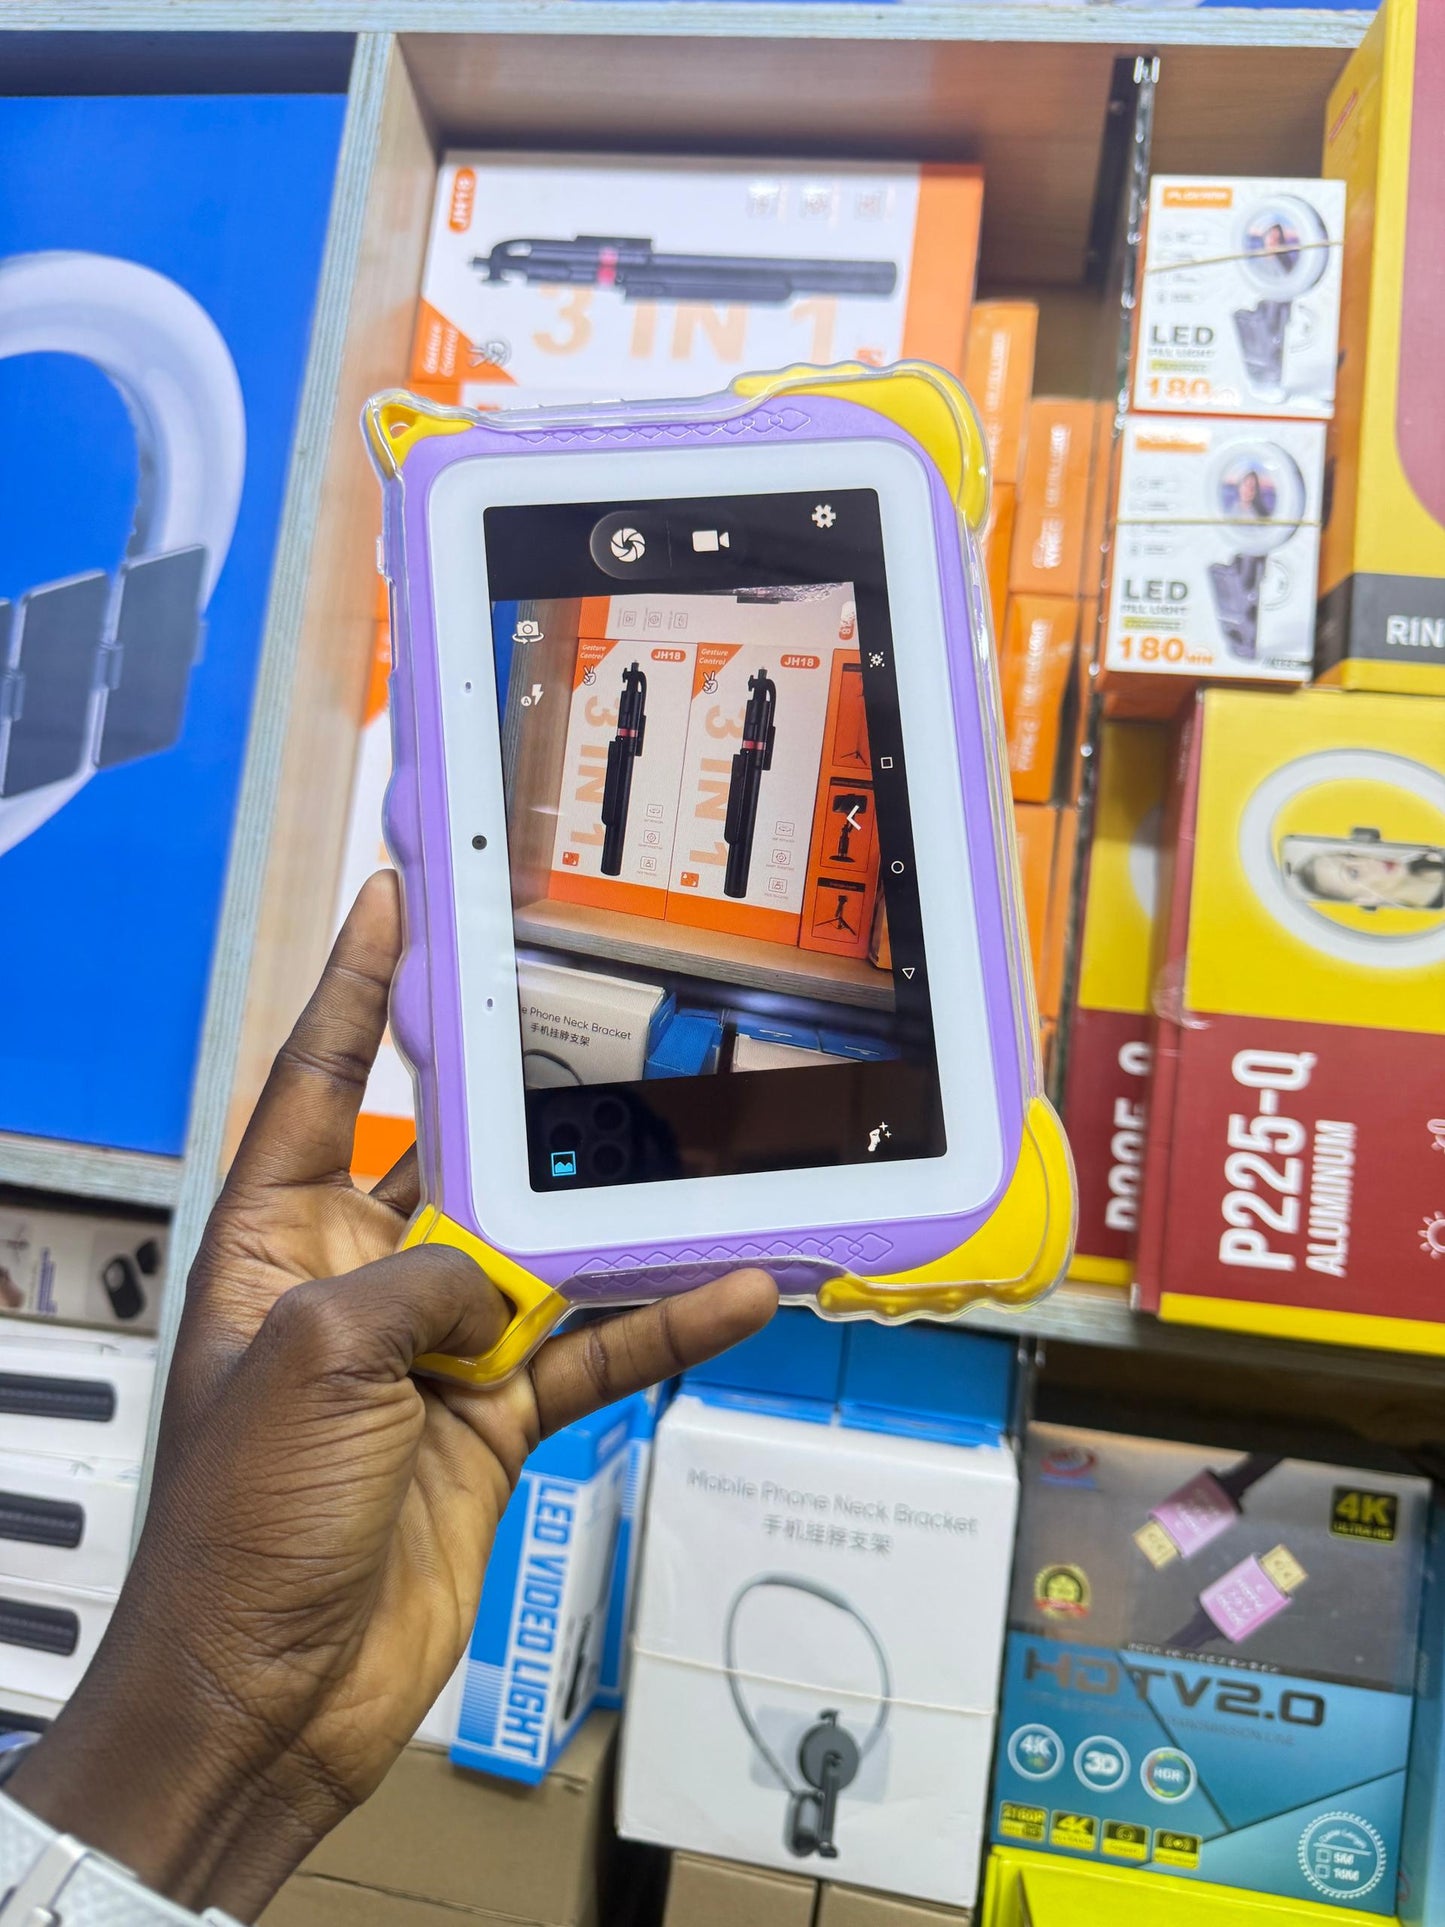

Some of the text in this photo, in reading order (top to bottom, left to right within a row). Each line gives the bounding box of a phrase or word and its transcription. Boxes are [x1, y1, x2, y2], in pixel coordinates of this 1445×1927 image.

[1152, 325, 1215, 346] LED
[1123, 579, 1189, 602] LED
[653, 650, 682, 660] JH18
[701, 648, 729, 658] Gesture
[1119, 636, 1185, 662] 180
[784, 657, 815, 668] JH18
[530, 1007, 561, 1023] Phone
[563, 1015, 589, 1030] Neck
[592, 1022, 632, 1041] Bracket
[1219, 1049, 1317, 1272] P225-Q
[1305, 1119, 1358, 1278] ALUMINUM
[686, 1467, 980, 1534] Mobile Phone Neck Bracket
[1335, 1491, 1391, 1526] 4K
[500, 1478, 579, 1761] LED VIDEO LIGHT
[1019, 1734, 1053, 1758] 4K
[1083, 1750, 1121, 1776] 3D
[1058, 1815, 1092, 1834] 4K
